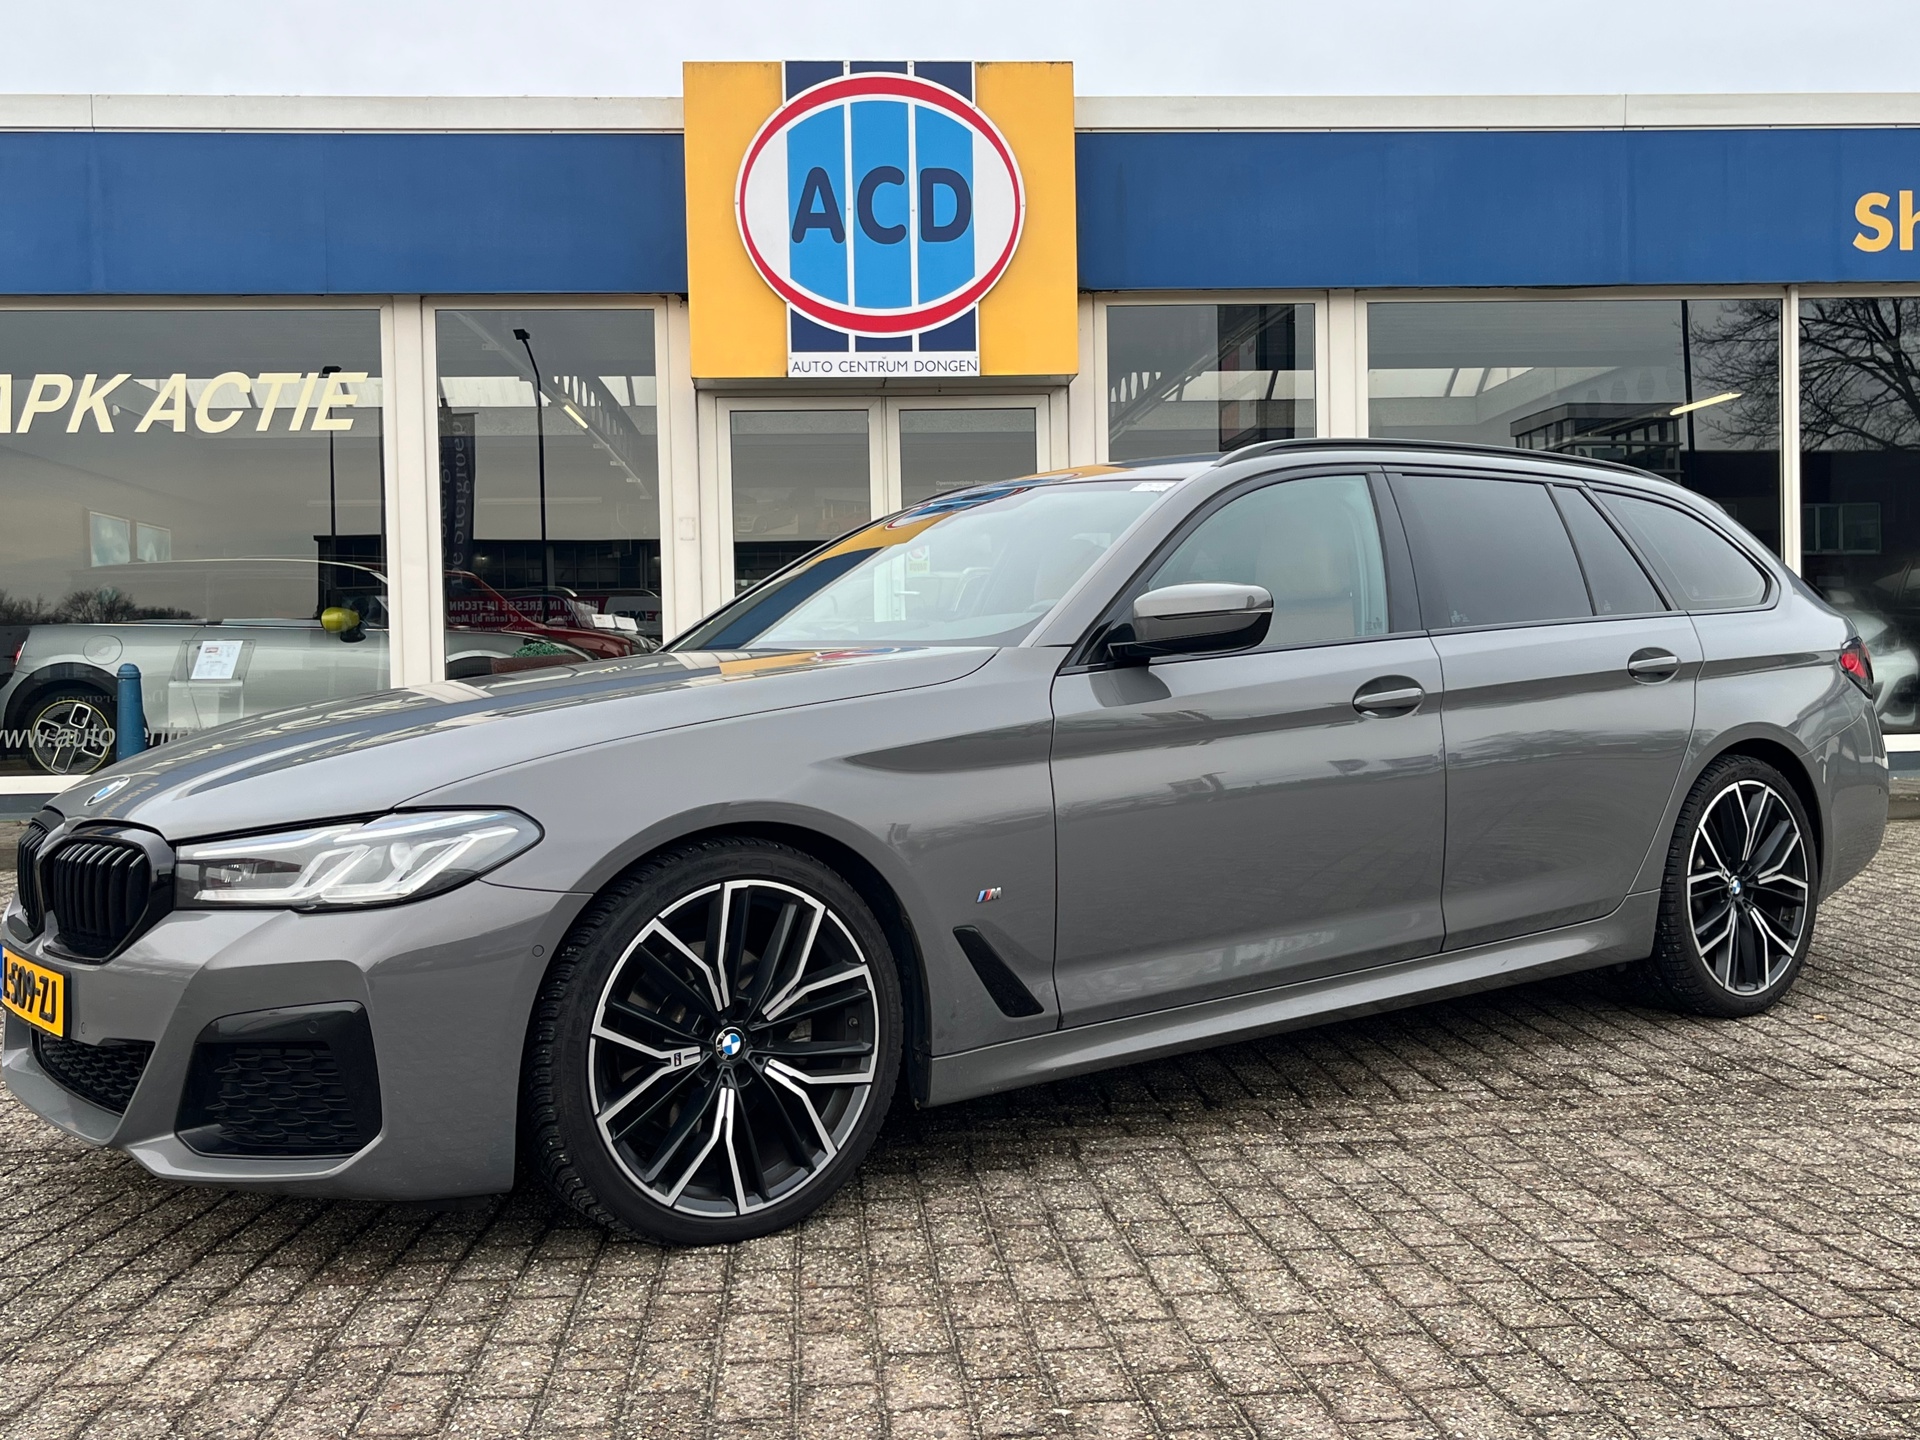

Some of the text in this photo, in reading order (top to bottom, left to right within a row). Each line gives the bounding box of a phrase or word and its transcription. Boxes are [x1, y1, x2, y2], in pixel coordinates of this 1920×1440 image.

[792, 166, 972, 244] ACD
[792, 360, 978, 373] AUTO CENTRUM DONGEN
[0, 371, 369, 434] PK ACTIE
[3, 956, 57, 1024] L-509-ZJ
